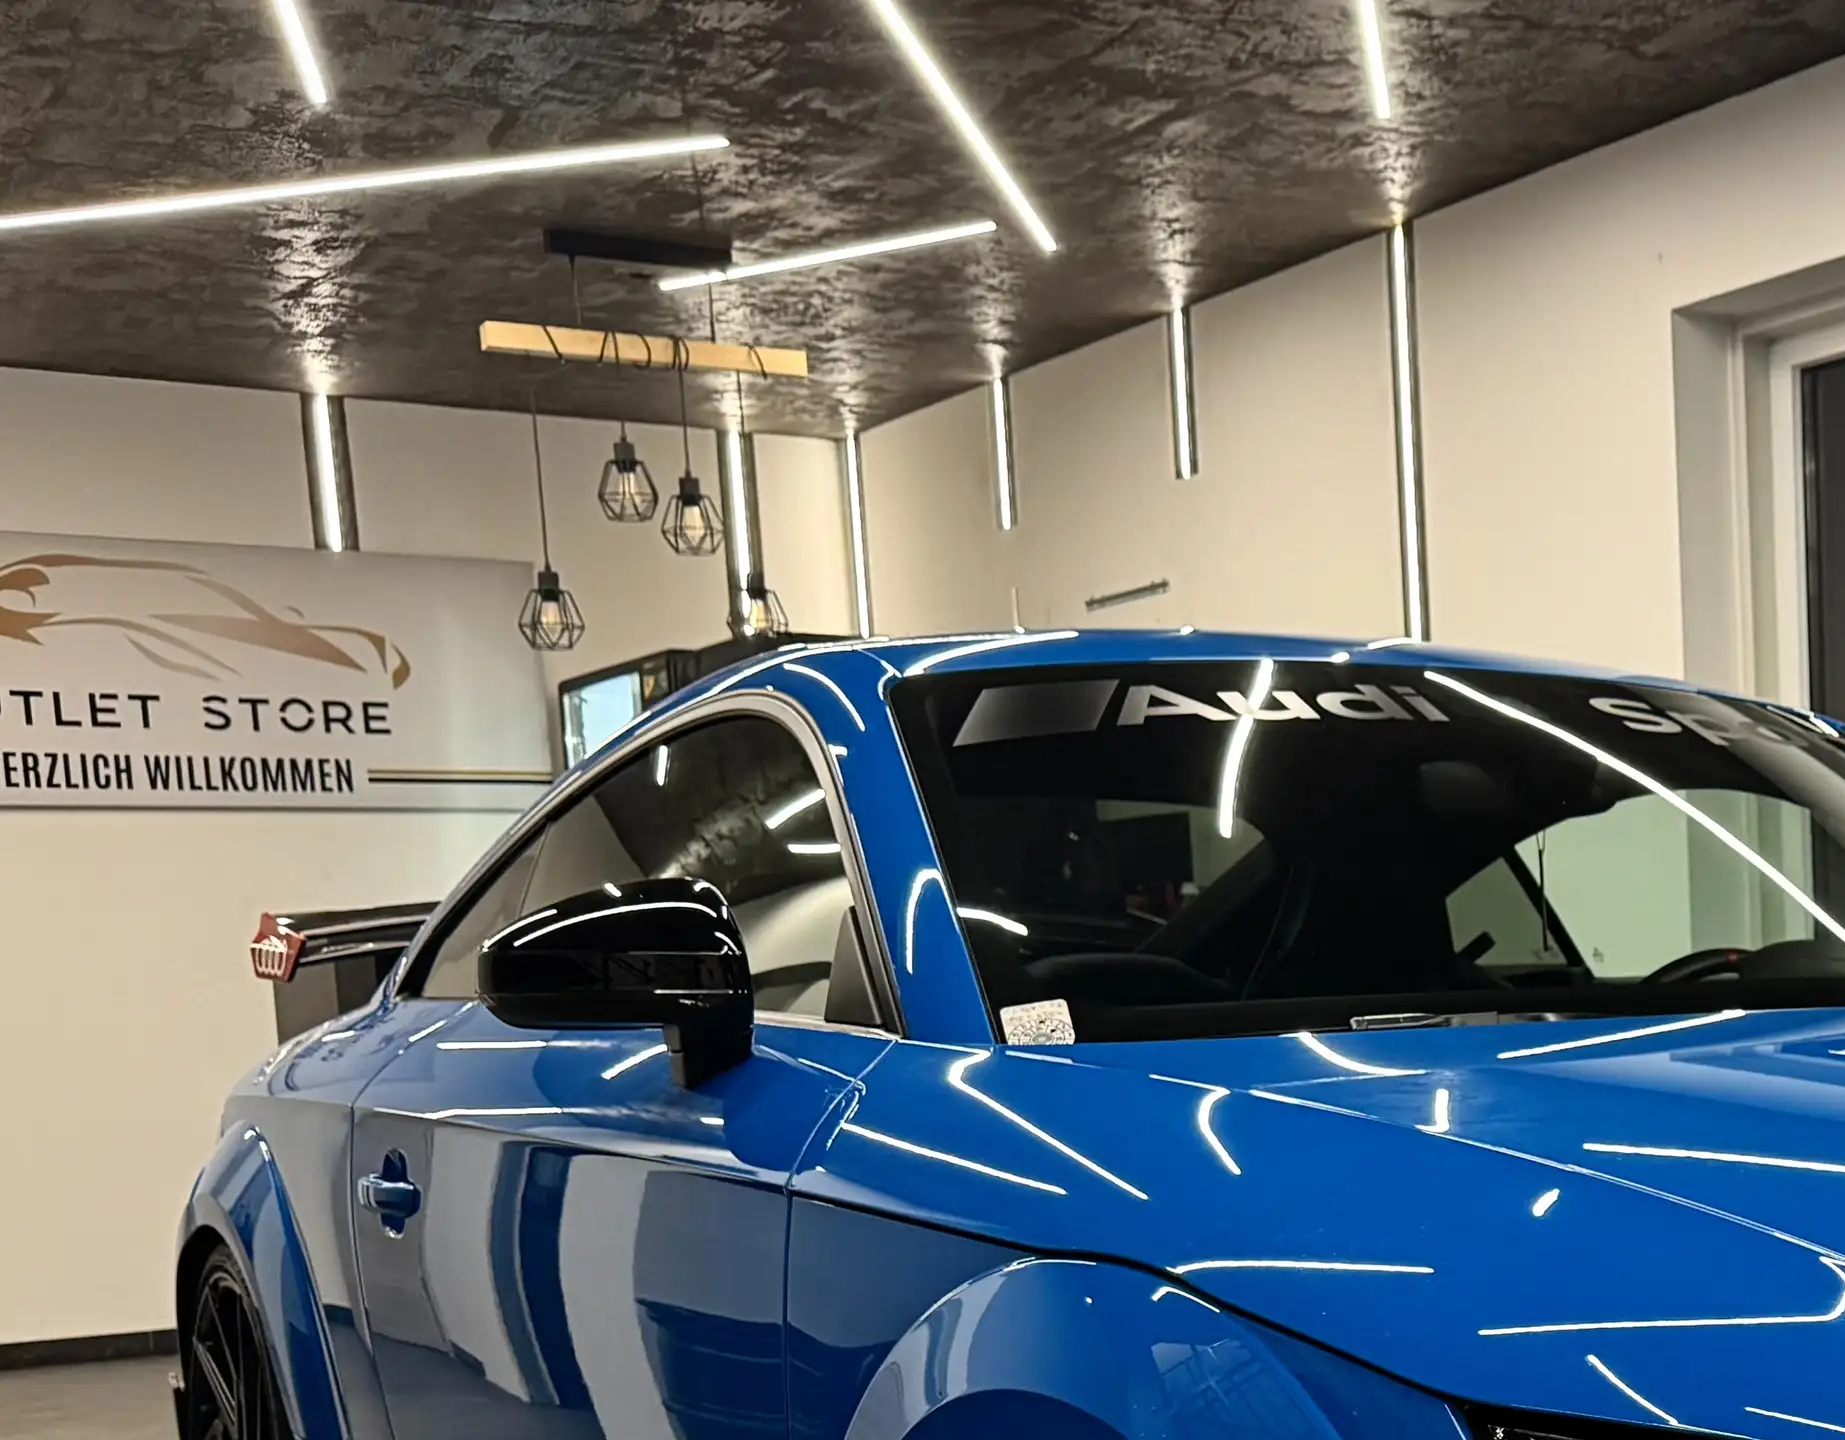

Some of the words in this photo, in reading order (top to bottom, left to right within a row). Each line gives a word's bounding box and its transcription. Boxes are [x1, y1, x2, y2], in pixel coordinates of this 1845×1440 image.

[0, 690, 160, 729] TLET
[202, 695, 393, 735] STORE
[1116, 683, 1450, 727] Audi
[2, 751, 135, 790] ERZLICH
[144, 753, 355, 794] WILLKOMMEN
